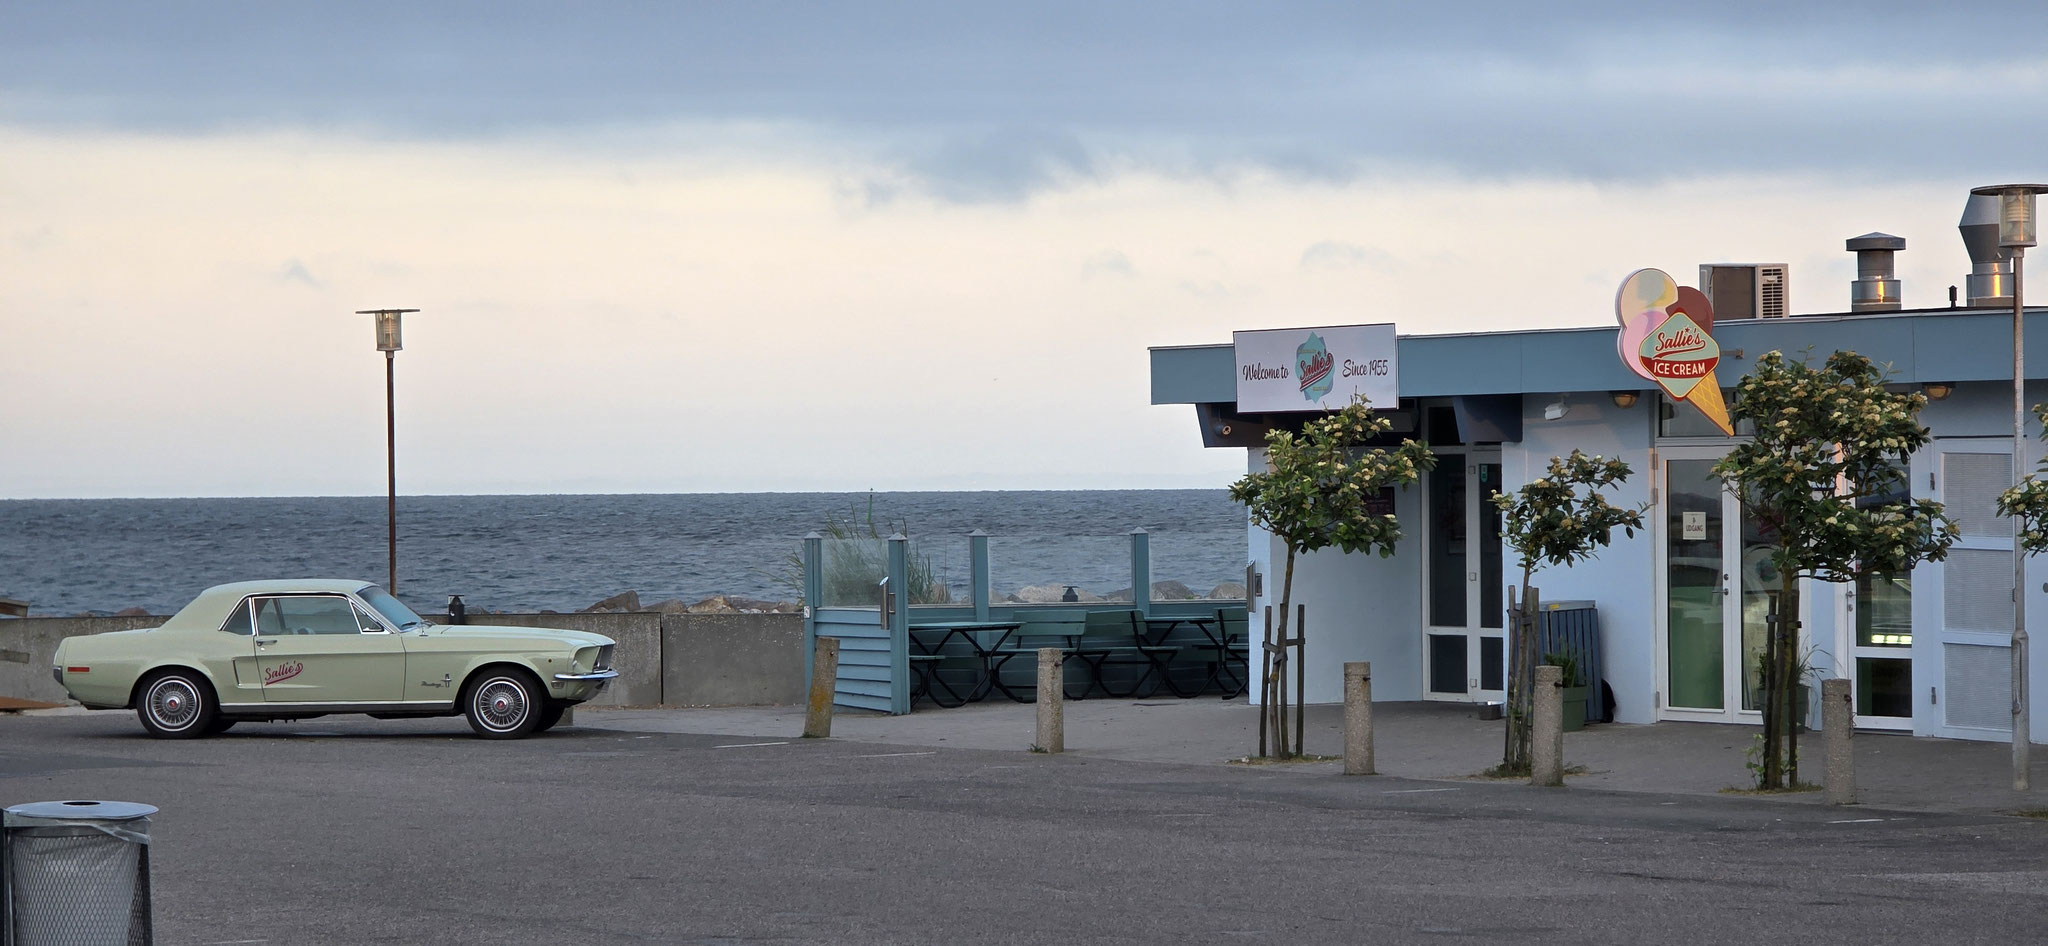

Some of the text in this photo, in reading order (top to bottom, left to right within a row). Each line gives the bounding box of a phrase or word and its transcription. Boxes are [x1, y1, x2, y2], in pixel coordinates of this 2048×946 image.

[1655, 327, 1706, 359] Sallie's
[1242, 362, 1289, 382] Welcome to
[1299, 349, 1335, 391] Sallie's
[1342, 359, 1389, 378] Since 1955
[1653, 361, 1706, 376] ICE CREAM
[264, 660, 304, 685] Sallie's
